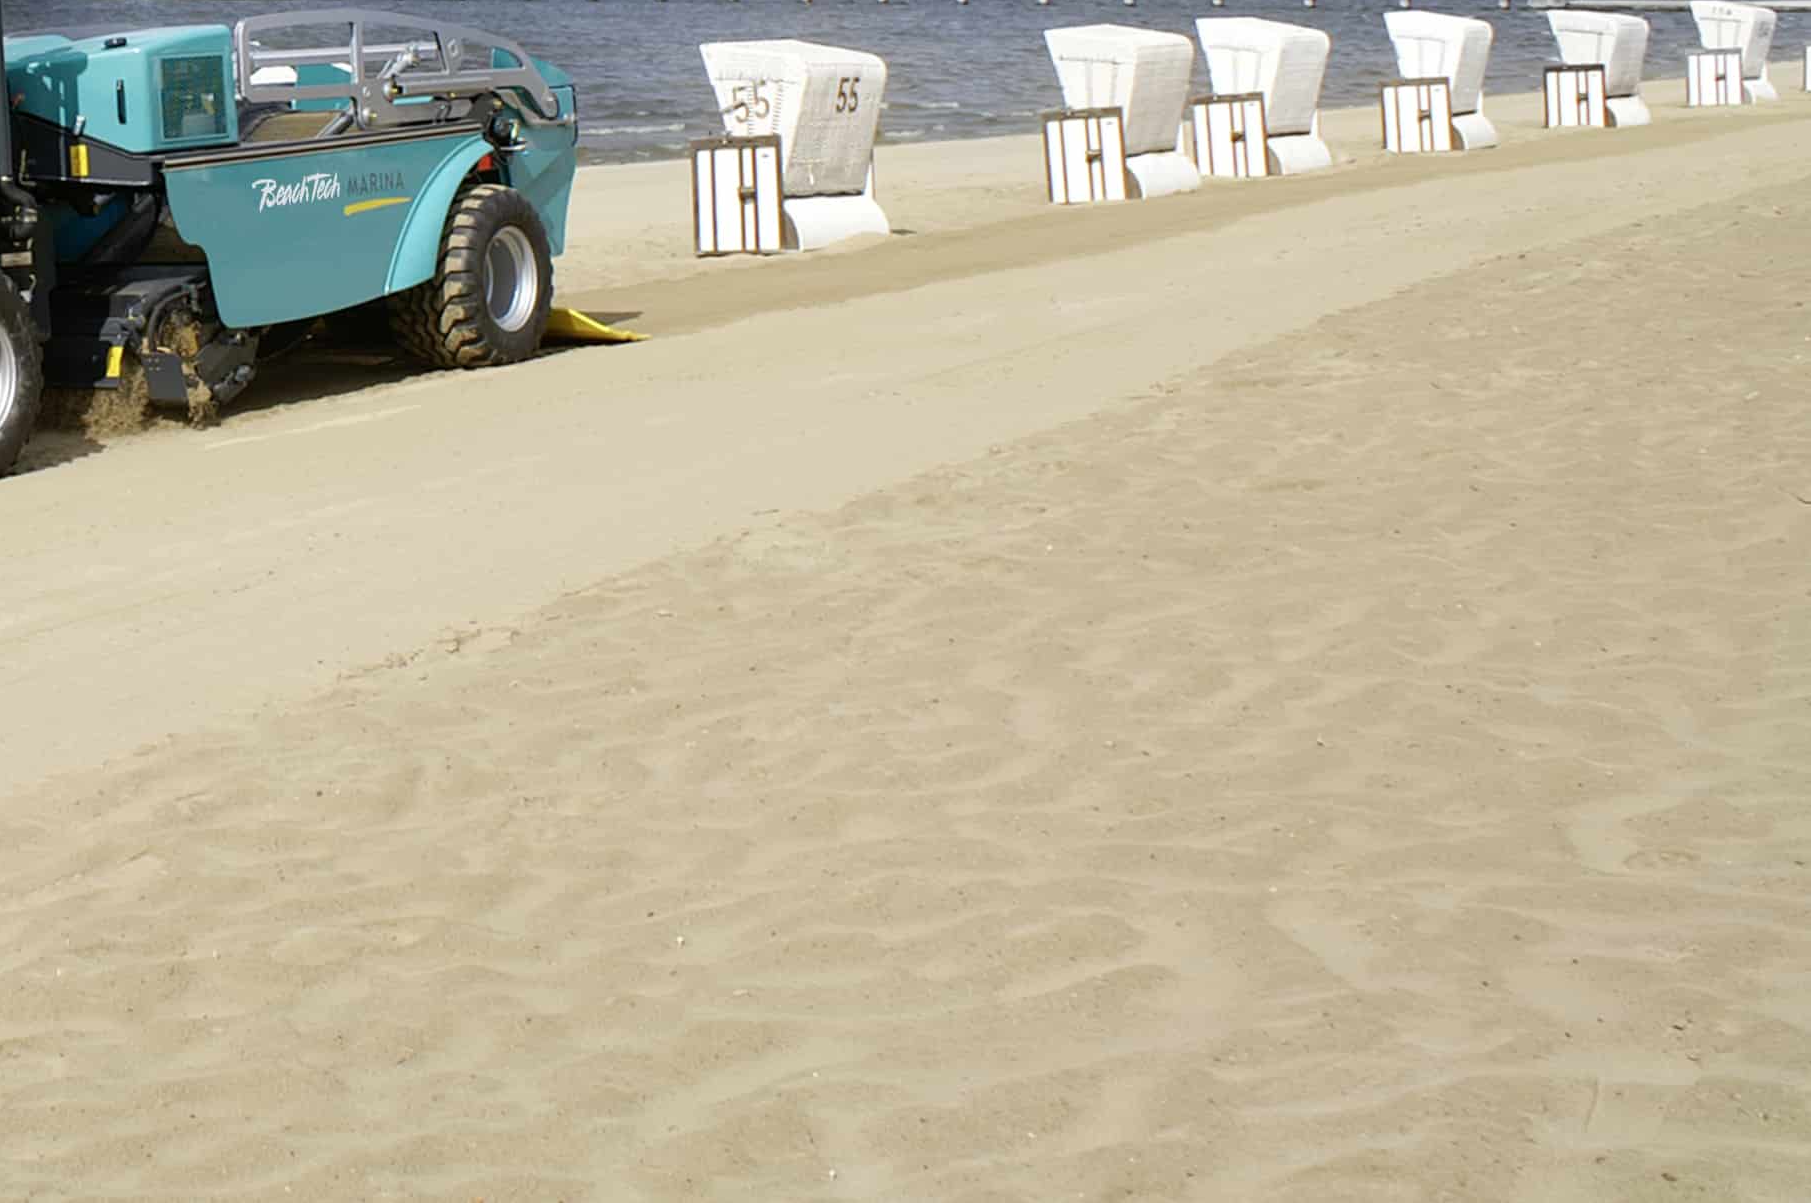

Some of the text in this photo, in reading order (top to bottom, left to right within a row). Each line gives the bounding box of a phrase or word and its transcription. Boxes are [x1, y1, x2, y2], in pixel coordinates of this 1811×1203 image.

[732, 79, 770, 124] 55
[835, 76, 861, 114] 55
[347, 171, 405, 196] MARINA
